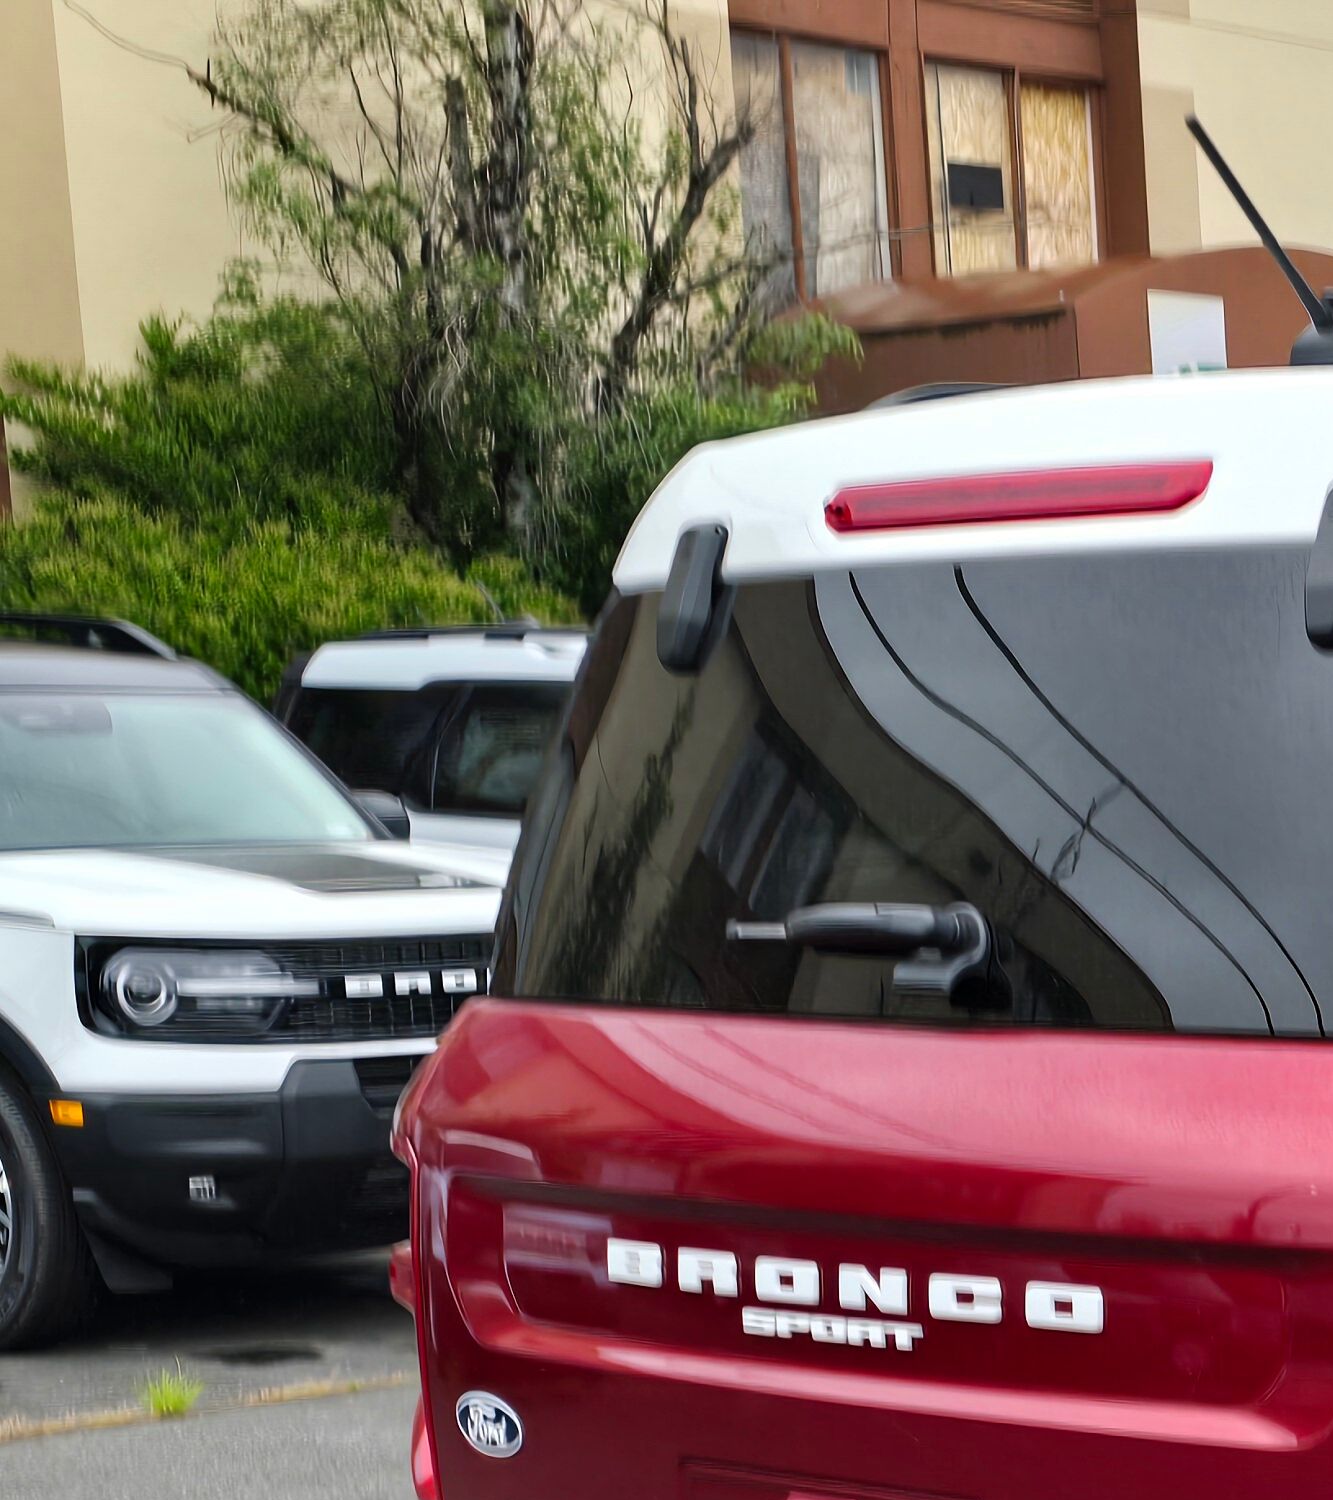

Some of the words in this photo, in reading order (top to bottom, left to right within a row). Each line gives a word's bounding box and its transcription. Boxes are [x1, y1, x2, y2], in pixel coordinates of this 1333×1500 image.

[344, 967, 492, 999] BRO
[607, 1237, 1104, 1334] BRONCO
[742, 1305, 924, 1352] SPORT
[464, 1397, 511, 1450] Ford
